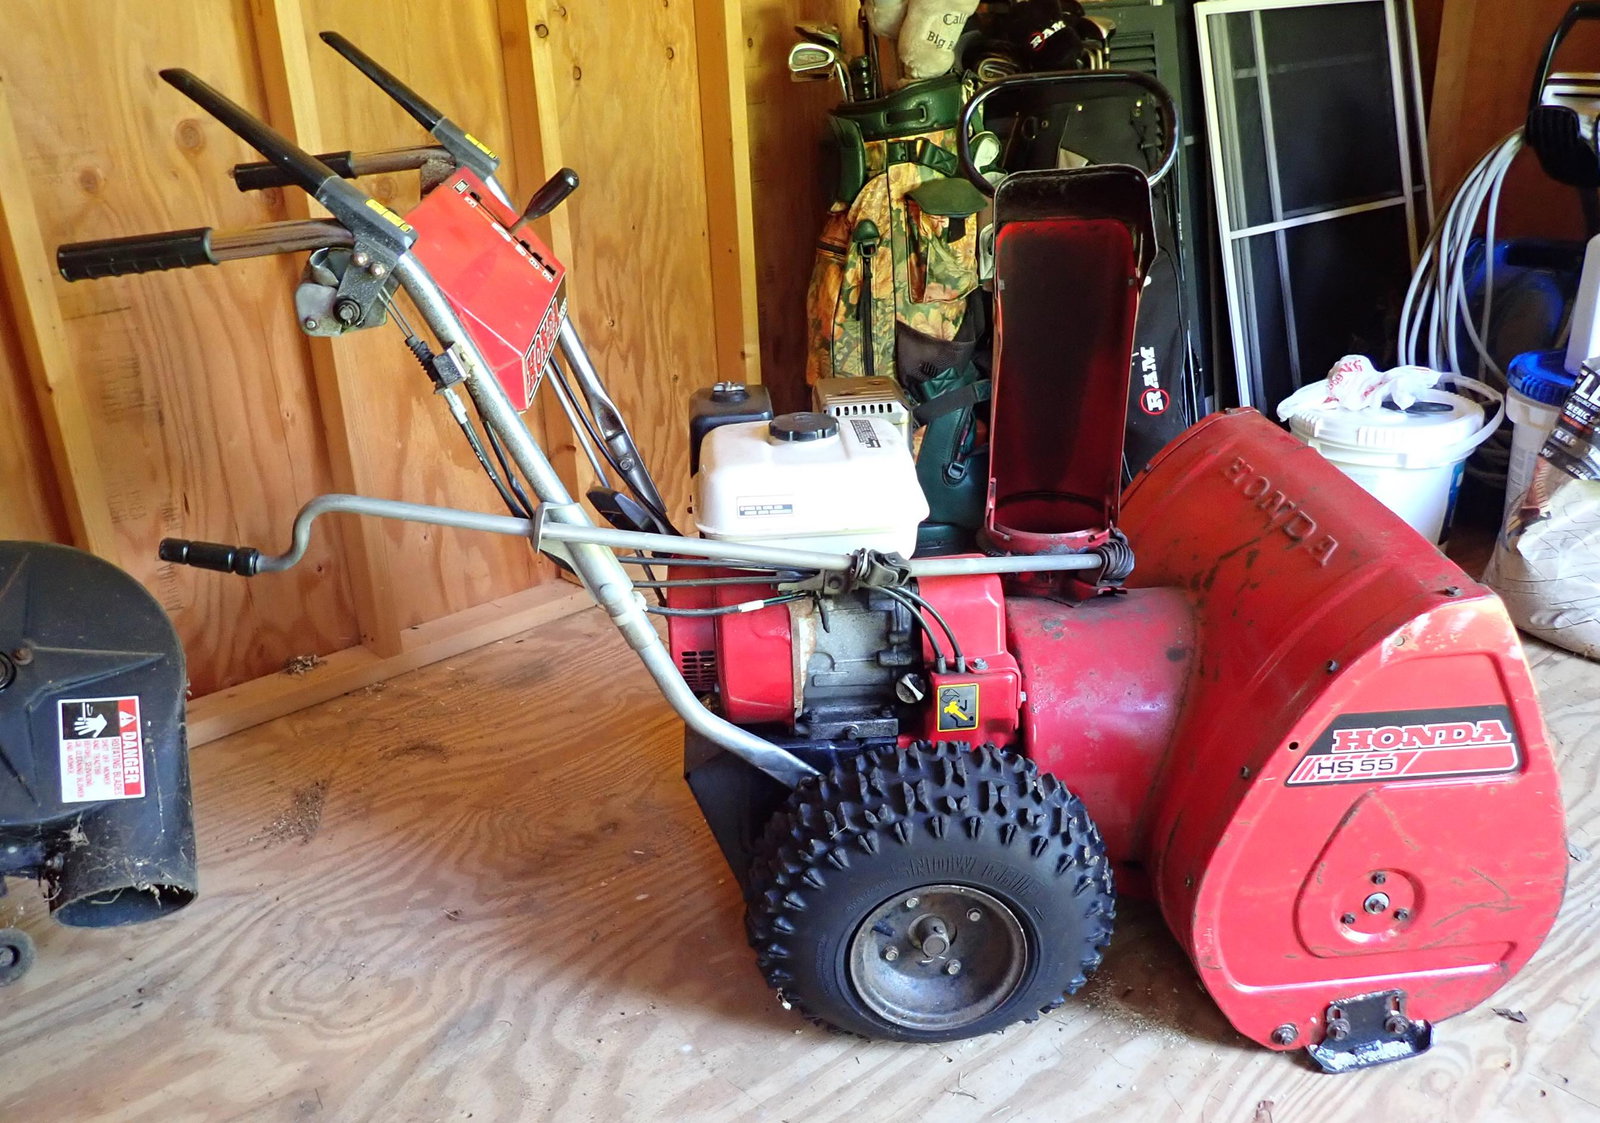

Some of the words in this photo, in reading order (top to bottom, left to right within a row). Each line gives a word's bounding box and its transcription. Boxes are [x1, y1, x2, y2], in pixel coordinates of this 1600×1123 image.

[926, 31, 946, 48] Big
[1030, 20, 1066, 49] RAM
[1140, 346, 1164, 412] RAM
[1223, 456, 1339, 567] HONDA
[1332, 719, 1512, 753] HONDA
[112, 739, 120, 769] ROTATING
[122, 731, 140, 784] DANGER
[1317, 760, 1353, 775] HS
[1360, 758, 1393, 772] 55
[113, 771, 122, 795] BLADES
